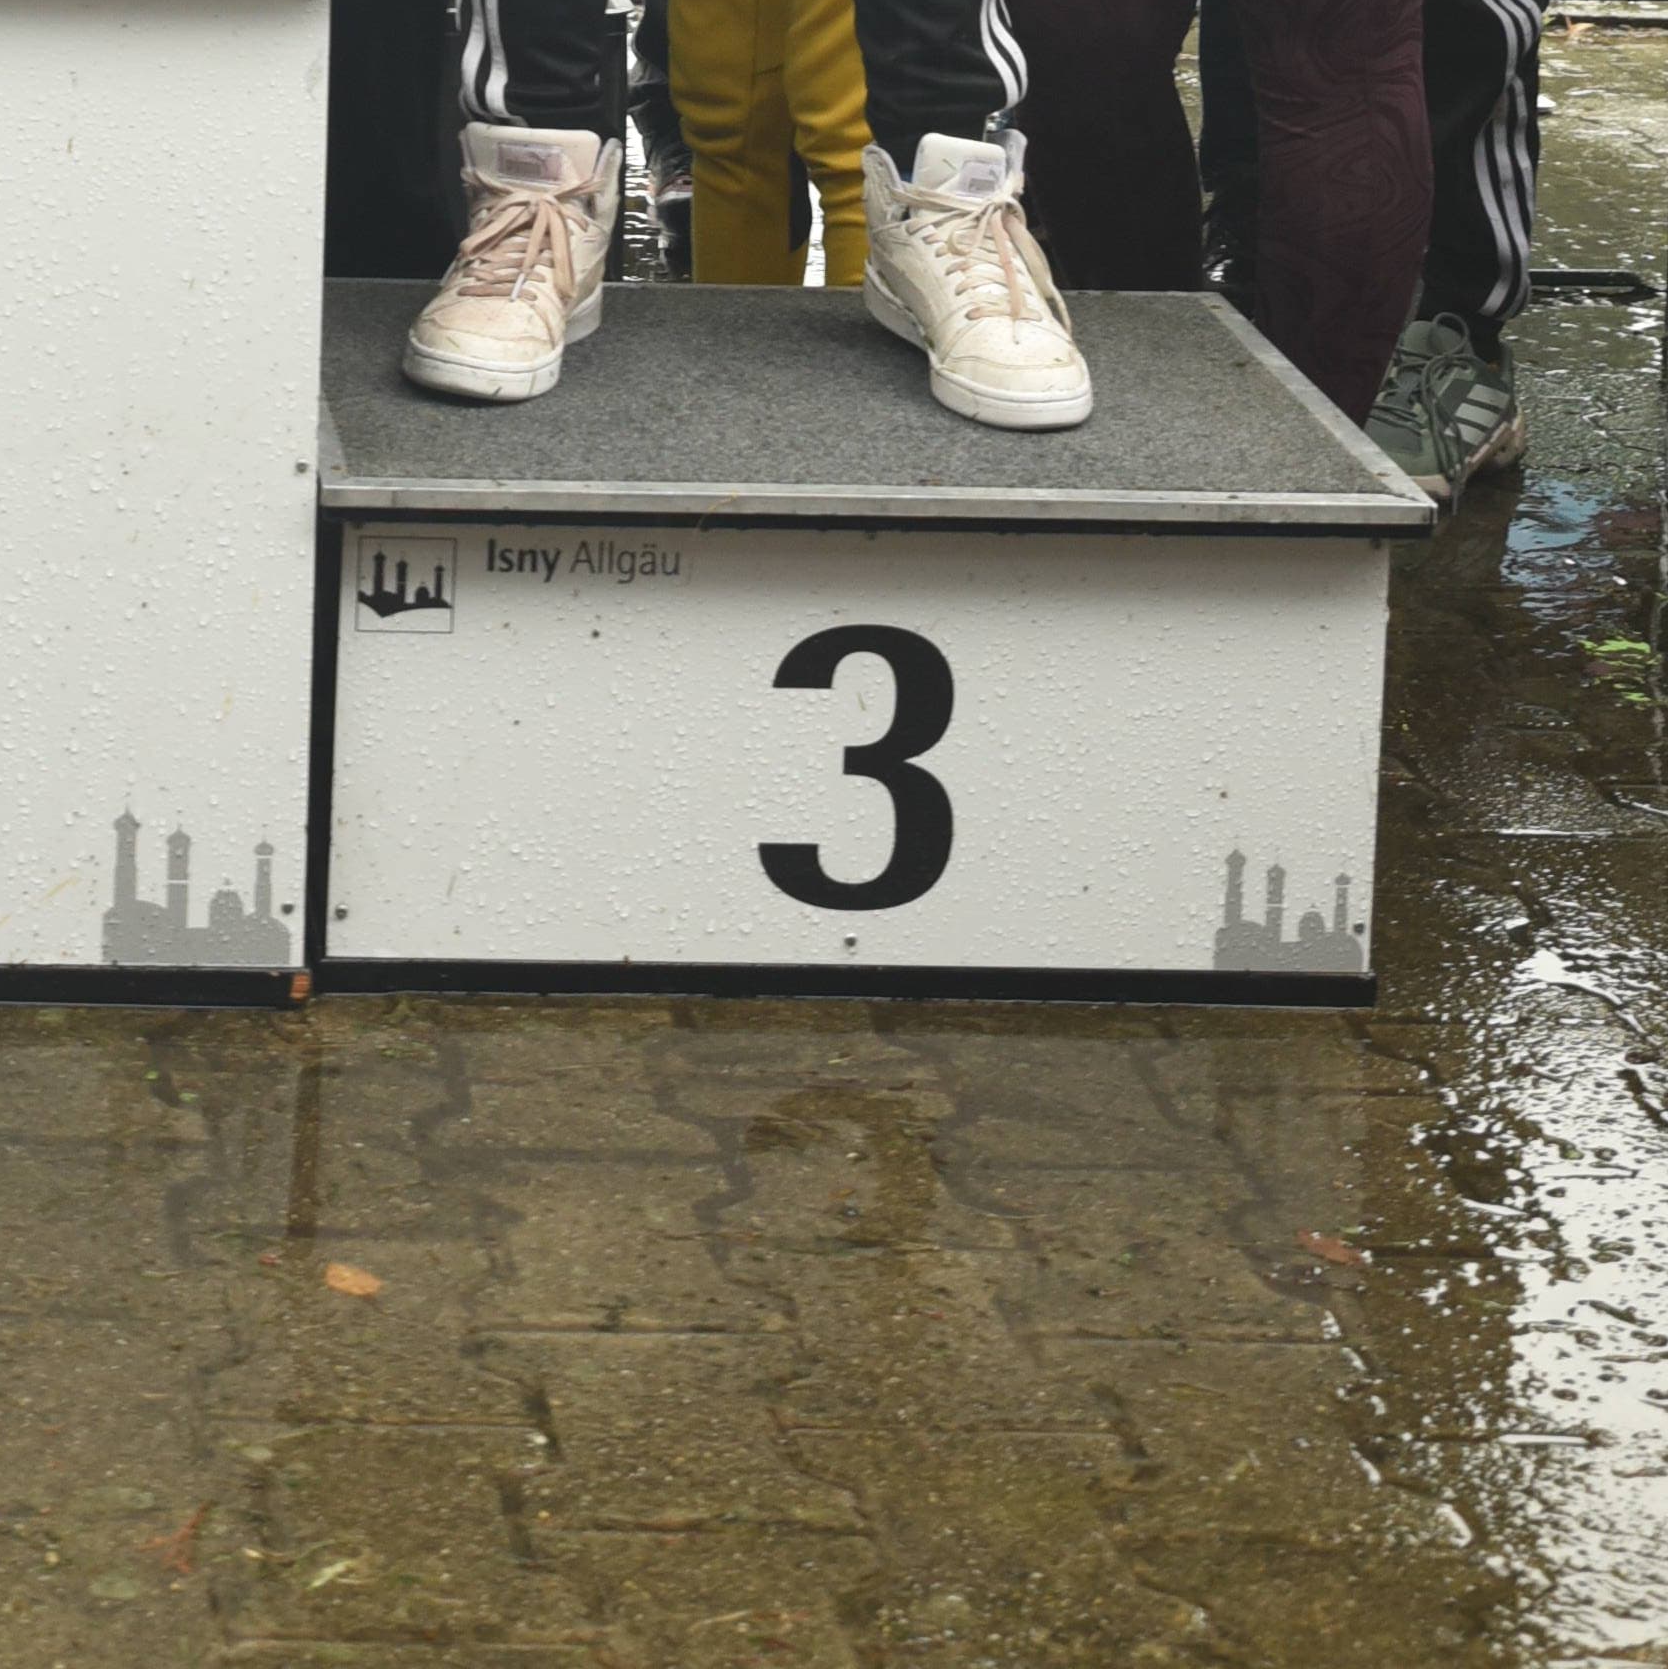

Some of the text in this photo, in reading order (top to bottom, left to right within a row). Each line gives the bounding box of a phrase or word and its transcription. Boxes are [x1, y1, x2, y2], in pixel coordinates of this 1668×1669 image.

[486, 538, 681, 584] Isny Allgäu
[757, 624, 955, 912] 3
